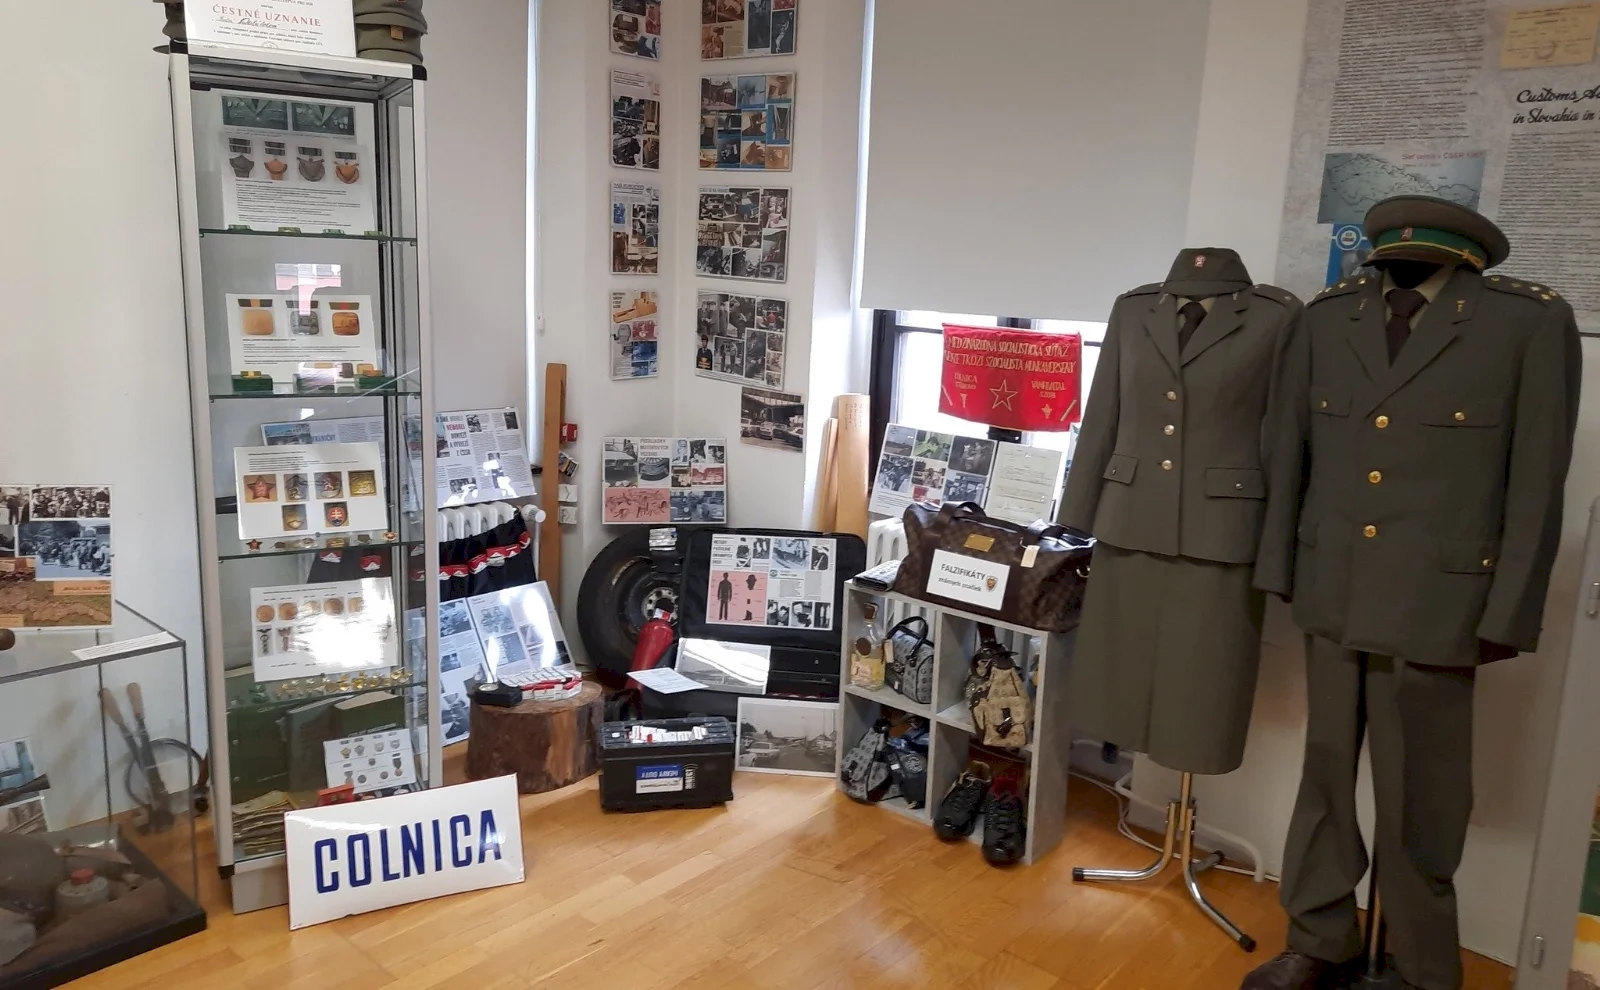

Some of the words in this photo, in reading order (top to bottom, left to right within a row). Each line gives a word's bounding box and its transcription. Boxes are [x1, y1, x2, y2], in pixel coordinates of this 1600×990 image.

[212, 4, 261, 19] ČESTNÉ
[265, 11, 322, 27] UZNANIE
[1516, 87, 1578, 104] Customs
[1512, 113, 1525, 124] in
[1527, 107, 1580, 124] Slovakia
[1582, 110, 1595, 121] in
[940, 563, 986, 581] FALZIFIKÁTY
[314, 809, 502, 894] COLNICA
